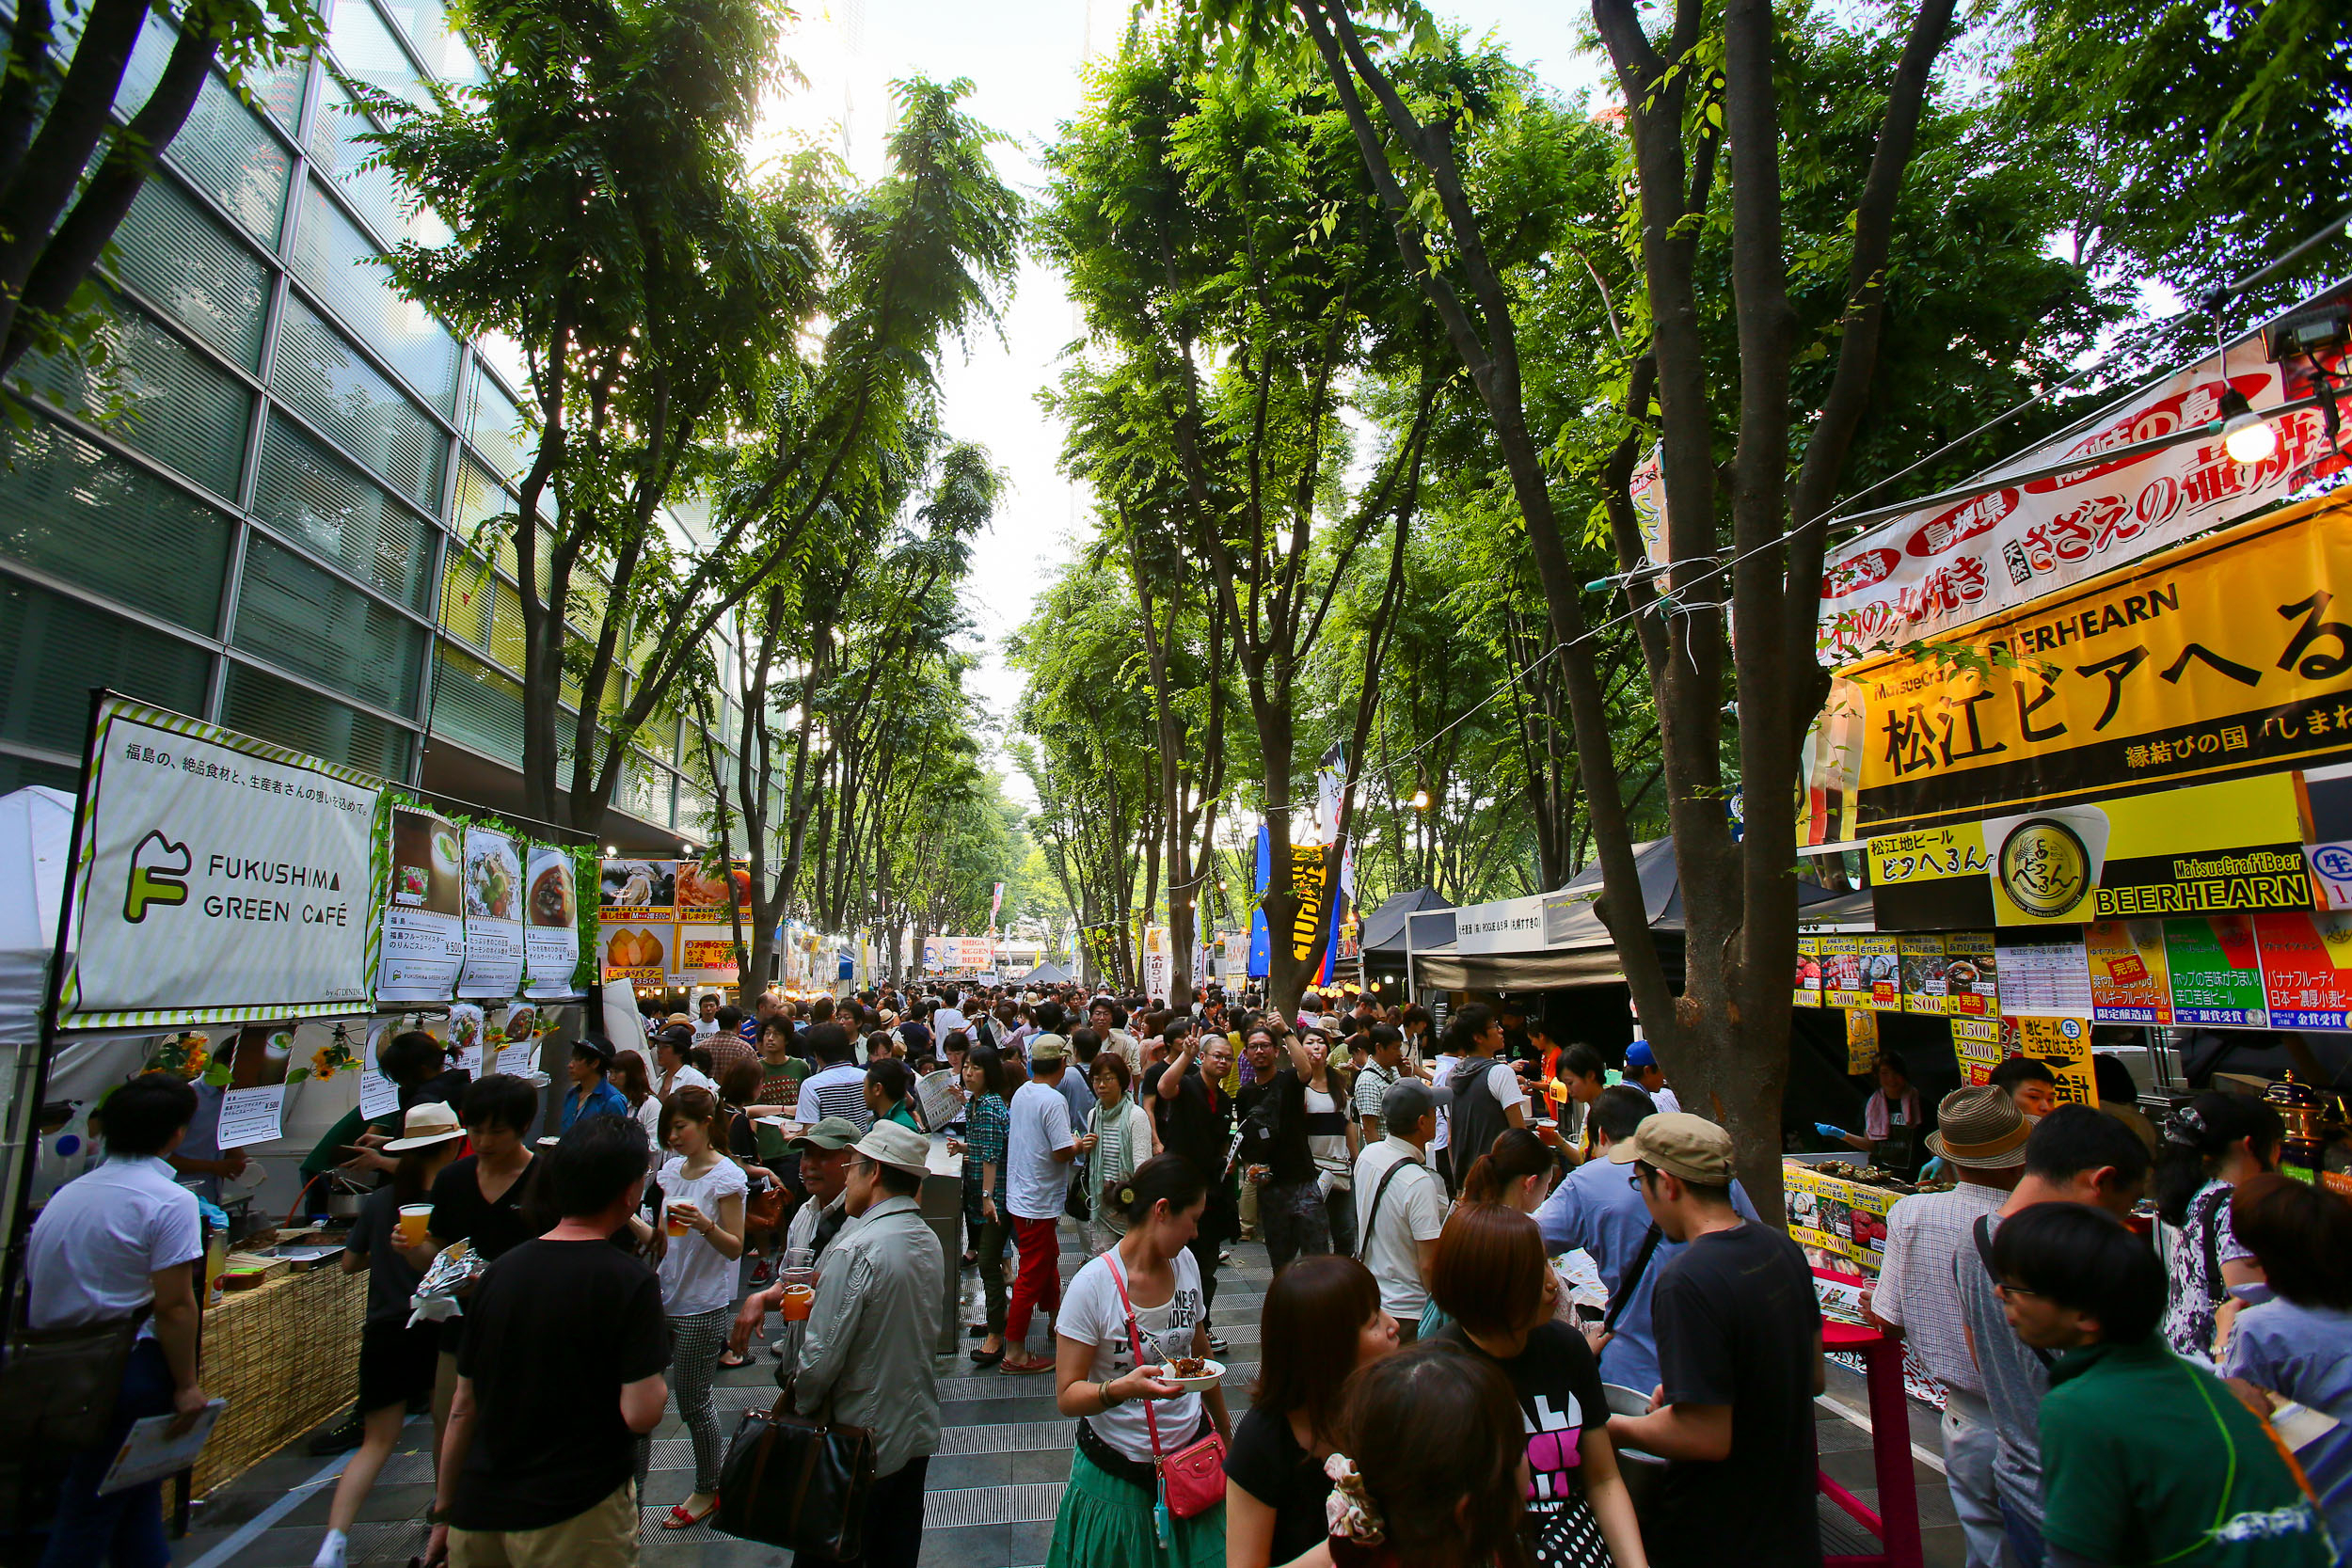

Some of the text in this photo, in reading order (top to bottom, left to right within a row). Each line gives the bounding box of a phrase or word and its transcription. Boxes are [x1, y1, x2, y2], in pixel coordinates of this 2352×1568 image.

[1923, 491, 2009, 555] 島根県
[2004, 542, 2032, 585] 天然
[1828, 551, 1888, 596] 日本海
[2124, 724, 2249, 768] 縁結びの国
[126, 742, 368, 816] 福島の、絶品食材と、生産者さんの想いを込めて。
[1870, 830, 1954, 857] 松江地ビール
[1882, 845, 1996, 882] ビアへるん
[2173, 851, 2302, 880] MatsueCraftBeer
[2325, 852, 2352, 875] 生
[209, 854, 341, 891] FUKUSHIMA
[2092, 874, 2311, 916] BEERHEARN
[203, 895, 347, 927] GREEN CAFÉ
[1483, 922, 1496, 932] ROGUE
[389, 931, 445, 942] 福島フルーツマイスター
[694, 941, 734, 949] お得なセッ
[389, 941, 437, 951] のりんごスムージー
[445, 941, 462, 953] ¥500
[509, 944, 521, 955] ¥600
[607, 969, 662, 978] じゃがバター
[2112, 959, 2140, 976] 完売
[2267, 972, 2335, 987] バナナフルーティ
[326, 989, 333, 997] by
[1875, 984, 1891, 995] 完売
[2094, 990, 2168, 1006] ベルギーフルーツビール
[1962, 995, 1980, 1006] 完売
[2200, 1009, 2242, 1022] 銀賞受賞
[2297, 1012, 2342, 1026] 金賞受賞
[2025, 1019, 2077, 1036] 地ビール 生
[2028, 1037, 2084, 1055] ご注文はこちら
[2054, 1073, 2090, 1104] 会計
[1852, 1197, 1883, 1212] ステーキ串
